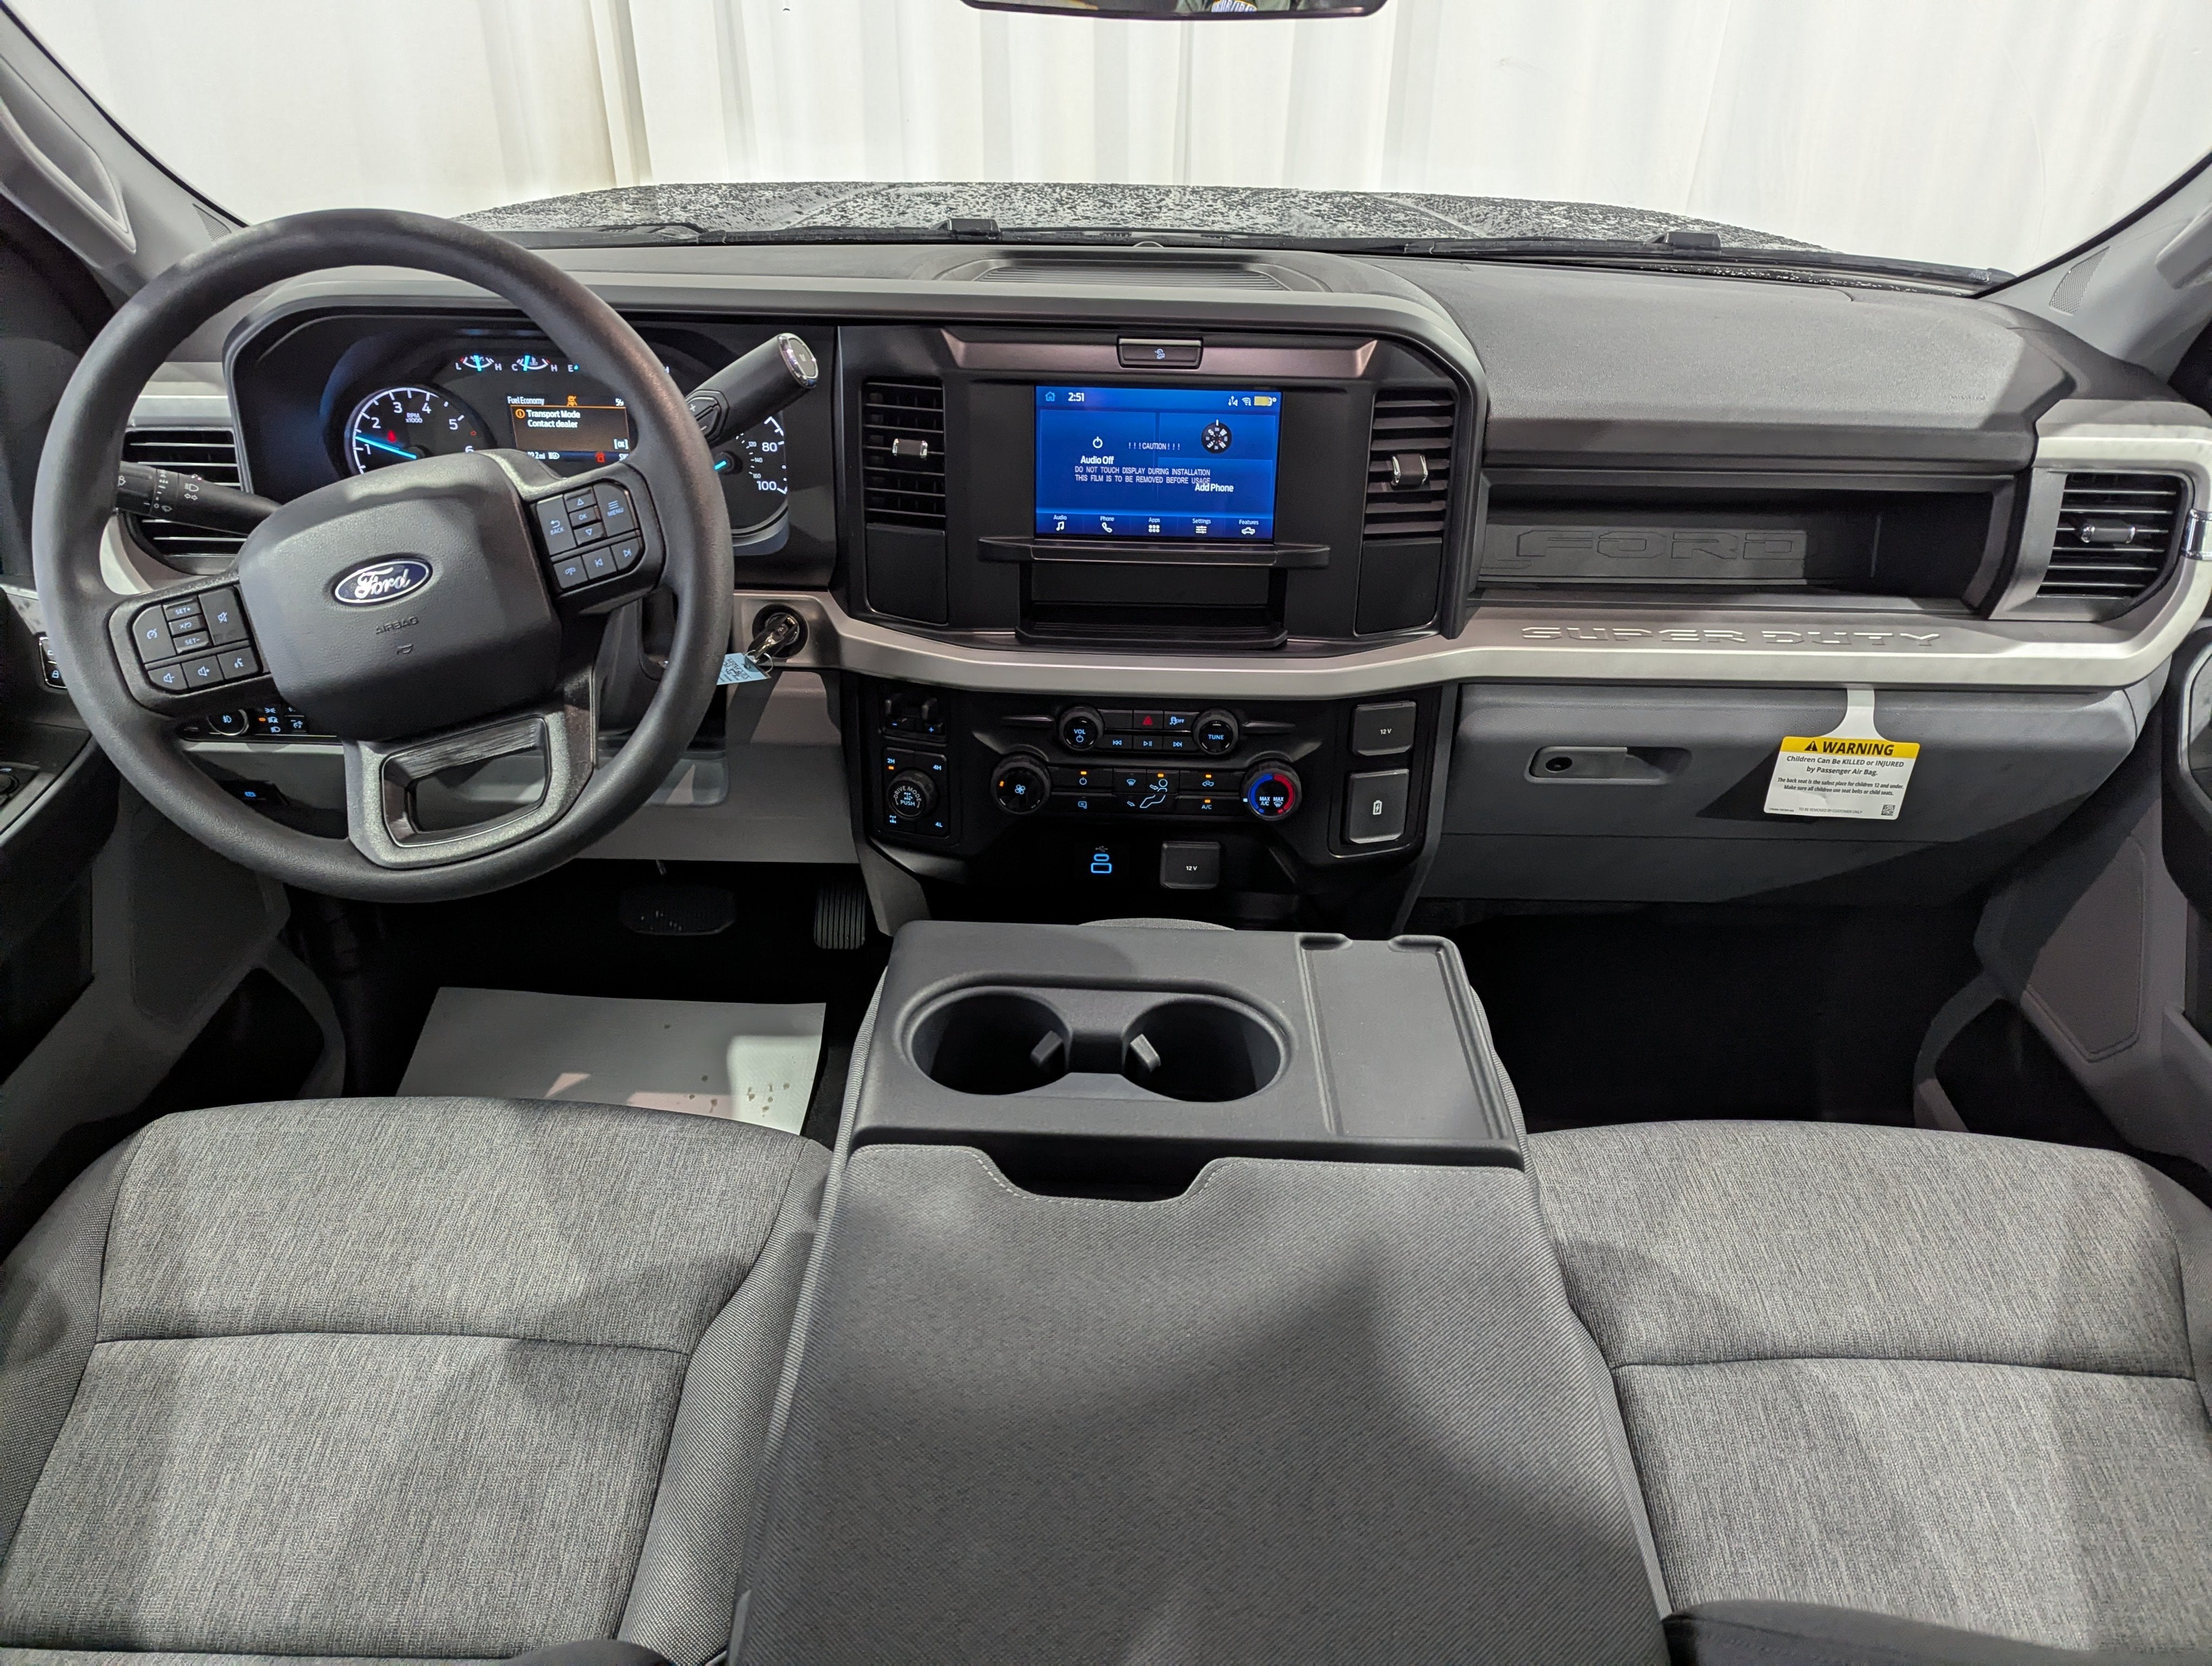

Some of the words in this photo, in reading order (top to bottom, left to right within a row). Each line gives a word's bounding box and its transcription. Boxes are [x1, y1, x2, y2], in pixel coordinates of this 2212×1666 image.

[455, 362, 461, 370] L
[507, 396, 519, 404] Fuel
[520, 397, 544, 406] Economy
[1068, 392, 1084, 402] 2:51
[393, 402, 403, 413] 3
[422, 402, 432, 414] 4
[526, 409, 560, 419] Transport
[561, 410, 581, 418] Mode
[371, 417, 381, 428] 2
[449, 419, 459, 430] 5
[364, 444, 371, 455] 1
[762, 442, 777, 452] 80
[1080, 456, 1101, 465] Audio
[1102, 456, 1115, 465] Off
[756, 480, 777, 491] 100
[1195, 483, 1210, 491] Add
[1211, 483, 1234, 492] Phone
[607, 507, 624, 517] MENU
[550, 527, 565, 535] BACK
[1516, 530, 1806, 560] FORD
[354, 567, 411, 599] Ford
[1522, 626, 1747, 643] SUPER
[1761, 630, 1940, 646] DUTY
[1823, 741, 1895, 756] WARNING
[1816, 767, 1851, 776] Passenger
[893, 785, 906, 799] DRIVE
[907, 786, 922, 802] MODE
